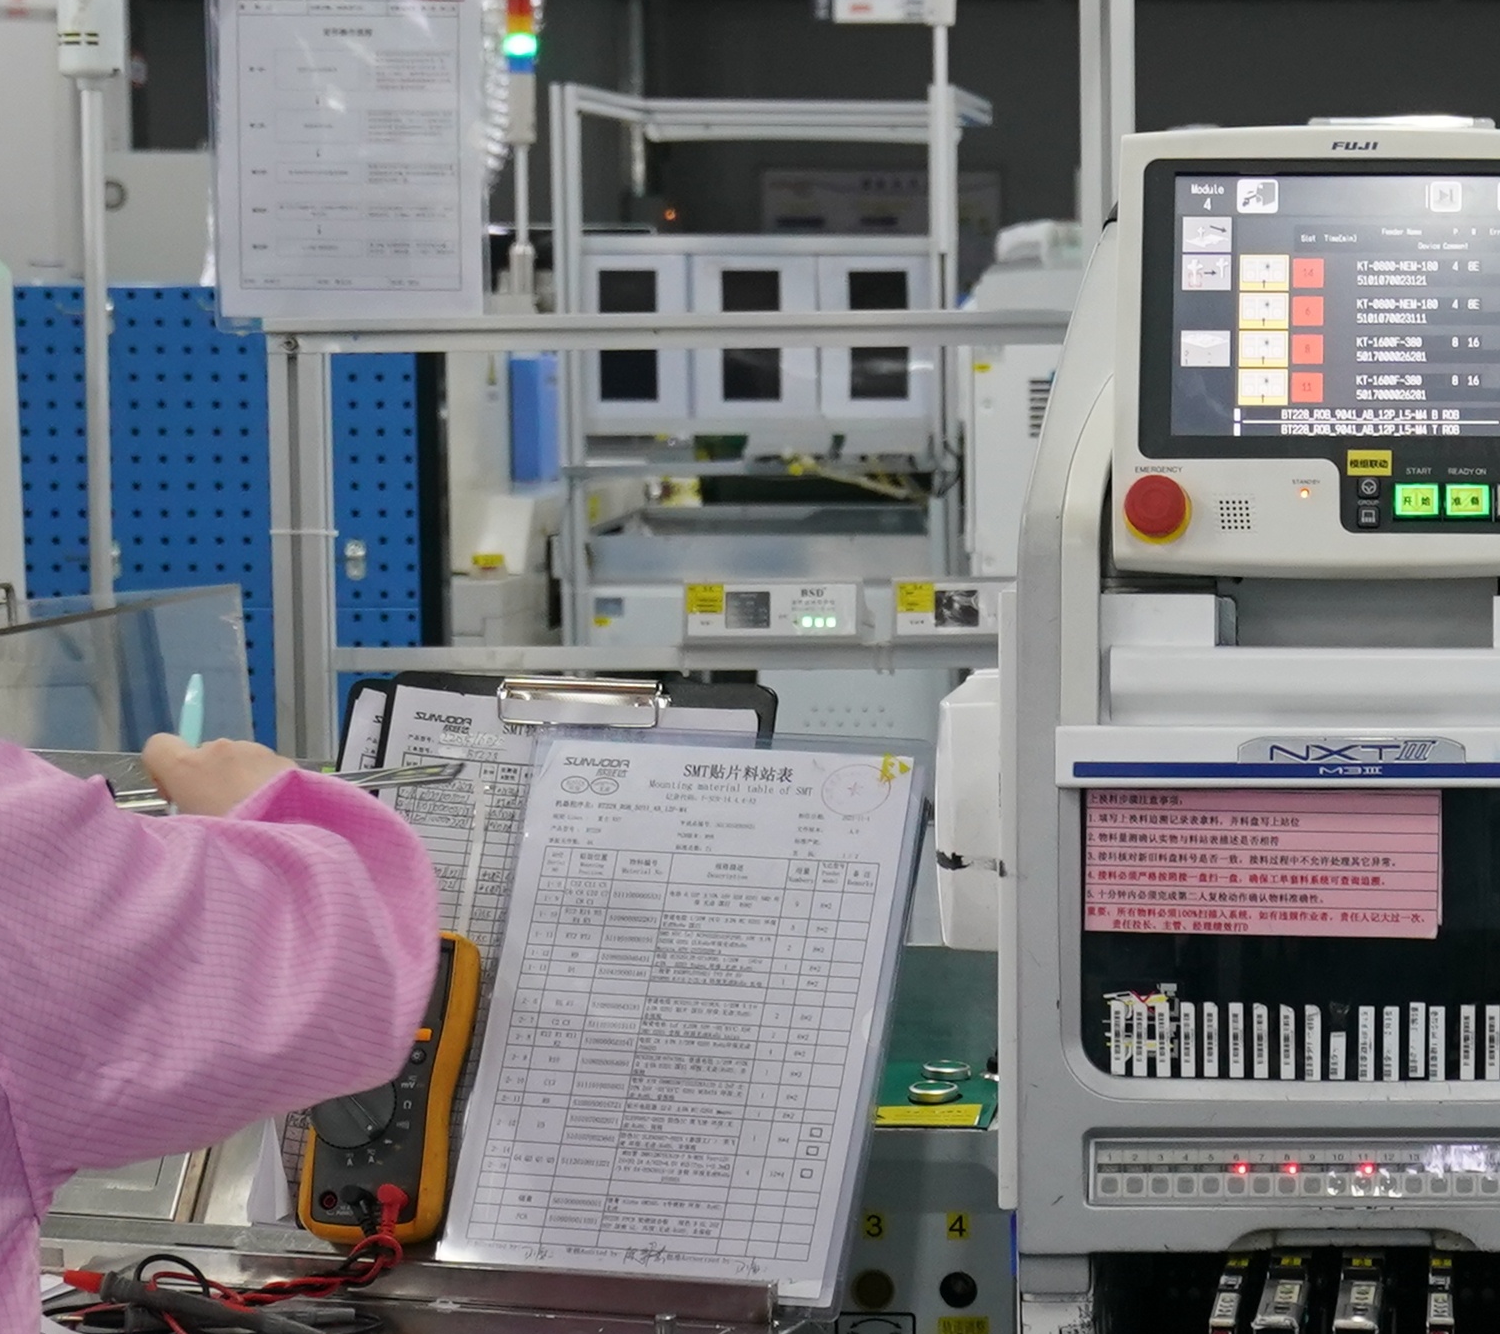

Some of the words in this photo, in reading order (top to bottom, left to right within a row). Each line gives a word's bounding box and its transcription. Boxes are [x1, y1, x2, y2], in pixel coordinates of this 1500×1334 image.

[1331, 141, 1379, 151] FUJI
[1191, 184, 1224, 195] Module
[1202, 198, 1212, 211] 4
[1134, 466, 1184, 474] EMERGENCY
[1405, 467, 1432, 475] START
[684, 764, 794, 782] SMT贴片料站表
[866, 1214, 883, 1237] 3
[948, 1214, 967, 1238] 4
